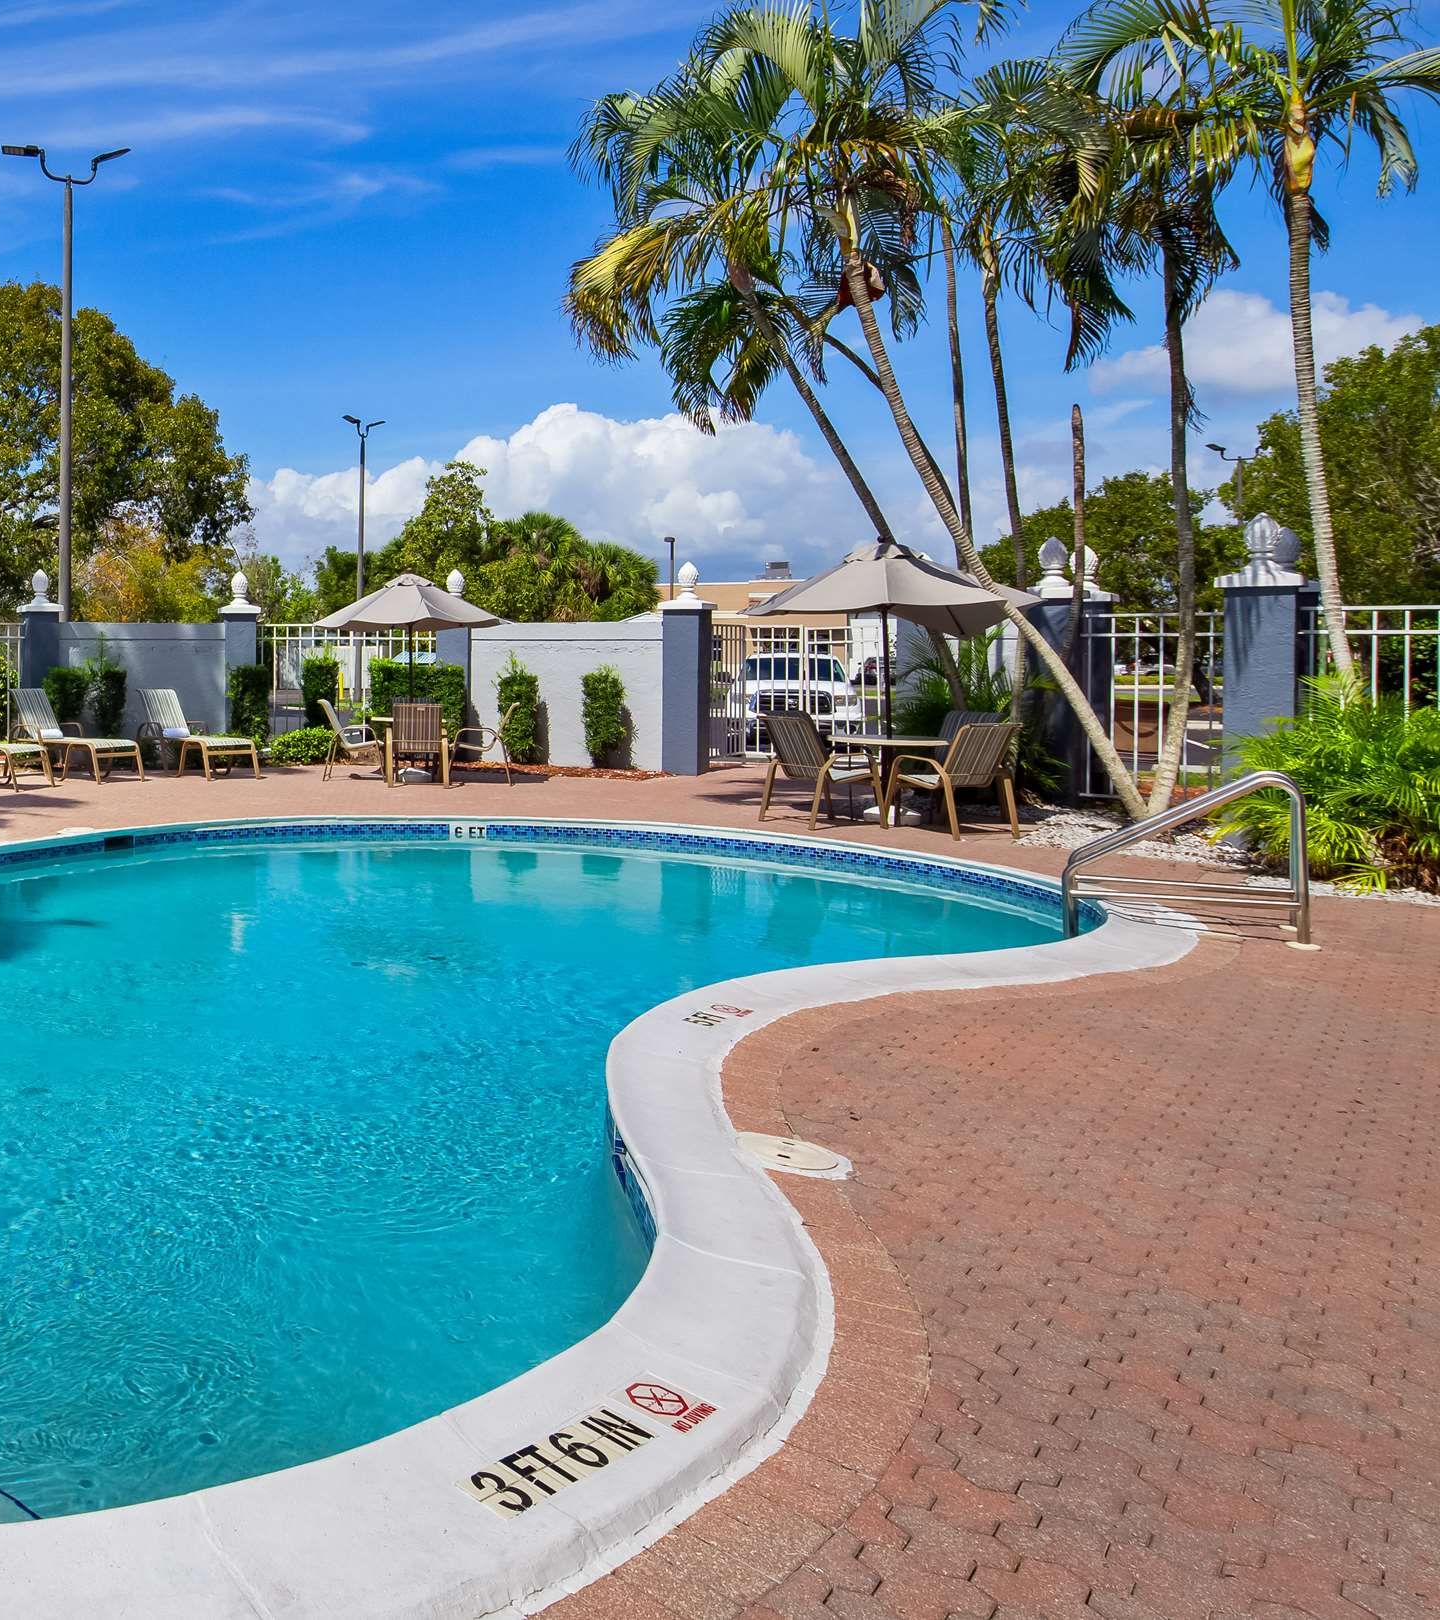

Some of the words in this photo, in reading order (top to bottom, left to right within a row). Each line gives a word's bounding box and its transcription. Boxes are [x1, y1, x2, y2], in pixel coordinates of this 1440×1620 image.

[580, 1409, 655, 1451] IN
[671, 1420, 692, 1433] NO
[682, 1403, 717, 1425] DIVING
[549, 1432, 609, 1467] 6
[499, 1444, 578, 1496] FT
[471, 1471, 533, 1511] 3
